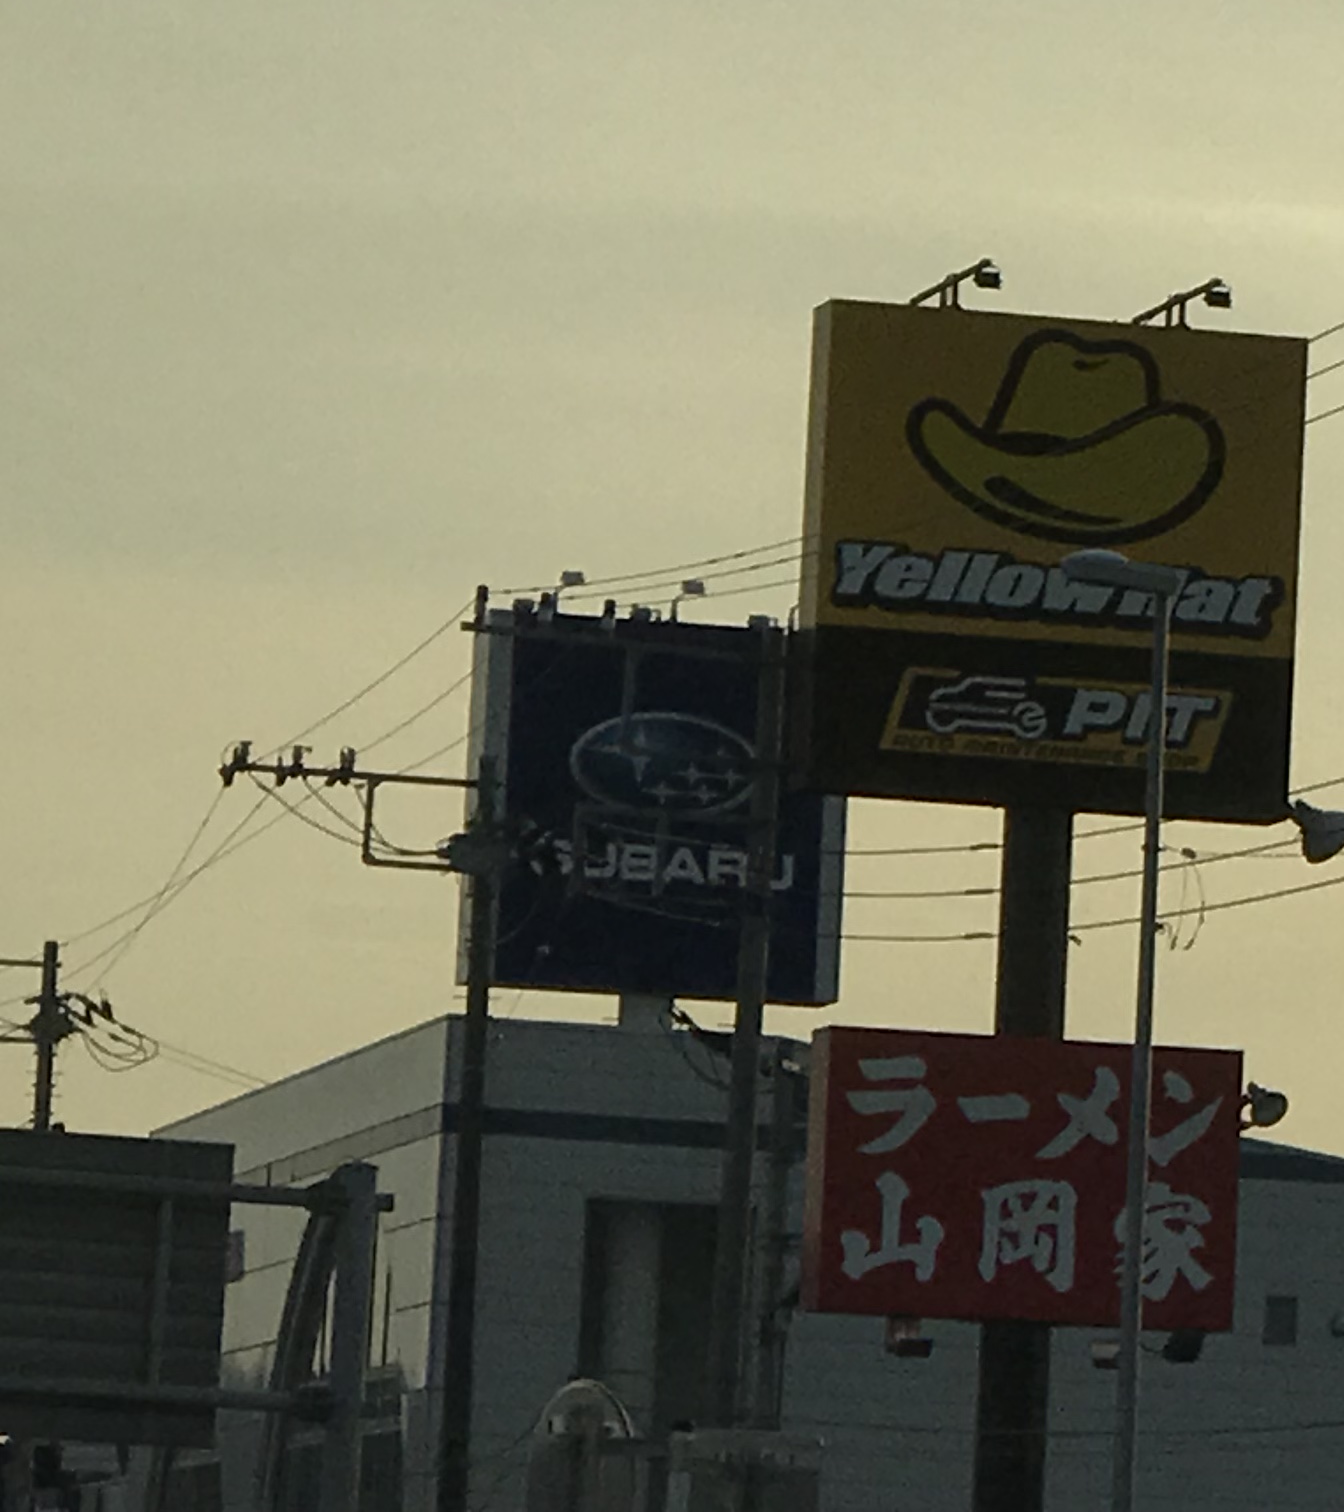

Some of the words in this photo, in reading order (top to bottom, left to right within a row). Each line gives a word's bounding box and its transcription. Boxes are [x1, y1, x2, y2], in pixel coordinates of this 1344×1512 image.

[1061, 687, 1219, 743] PIT
[845, 1055, 1224, 1167] ラーメン
[840, 1171, 1215, 1302] 山岡家
